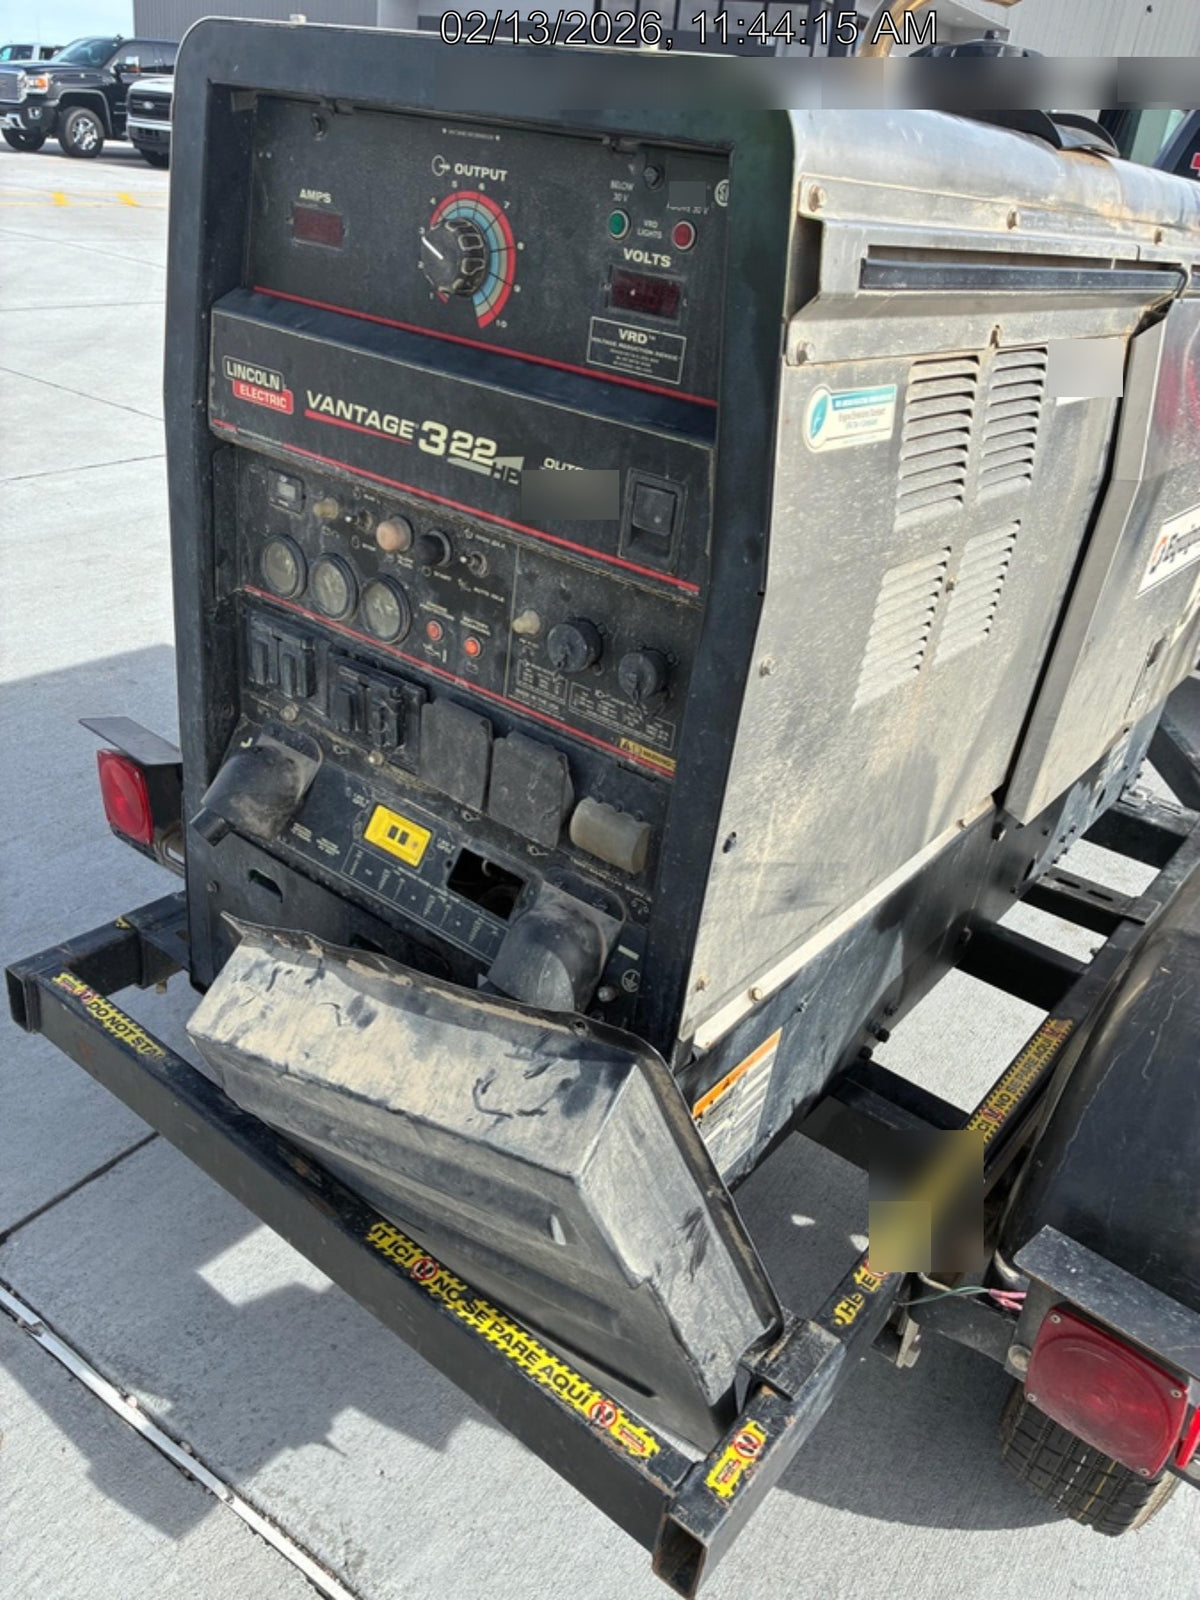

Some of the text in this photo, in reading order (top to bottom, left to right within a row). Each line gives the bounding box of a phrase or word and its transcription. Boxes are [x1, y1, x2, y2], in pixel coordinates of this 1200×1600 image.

[454, 162, 508, 182] OUTPUT
[299, 188, 331, 204] AMPS
[623, 247, 672, 269] VOLTS
[226, 360, 281, 391] LINCOLN
[240, 384, 287, 409] ELECTRIC
[306, 389, 498, 468] VANTAGE 322
[89, 1001, 109, 1018] DO
[107, 1016, 136, 1038] NOT
[388, 1241, 414, 1263] ICI
[433, 1276, 463, 1302] NO
[462, 1298, 492, 1325] SE
[488, 1319, 541, 1368] PARE
